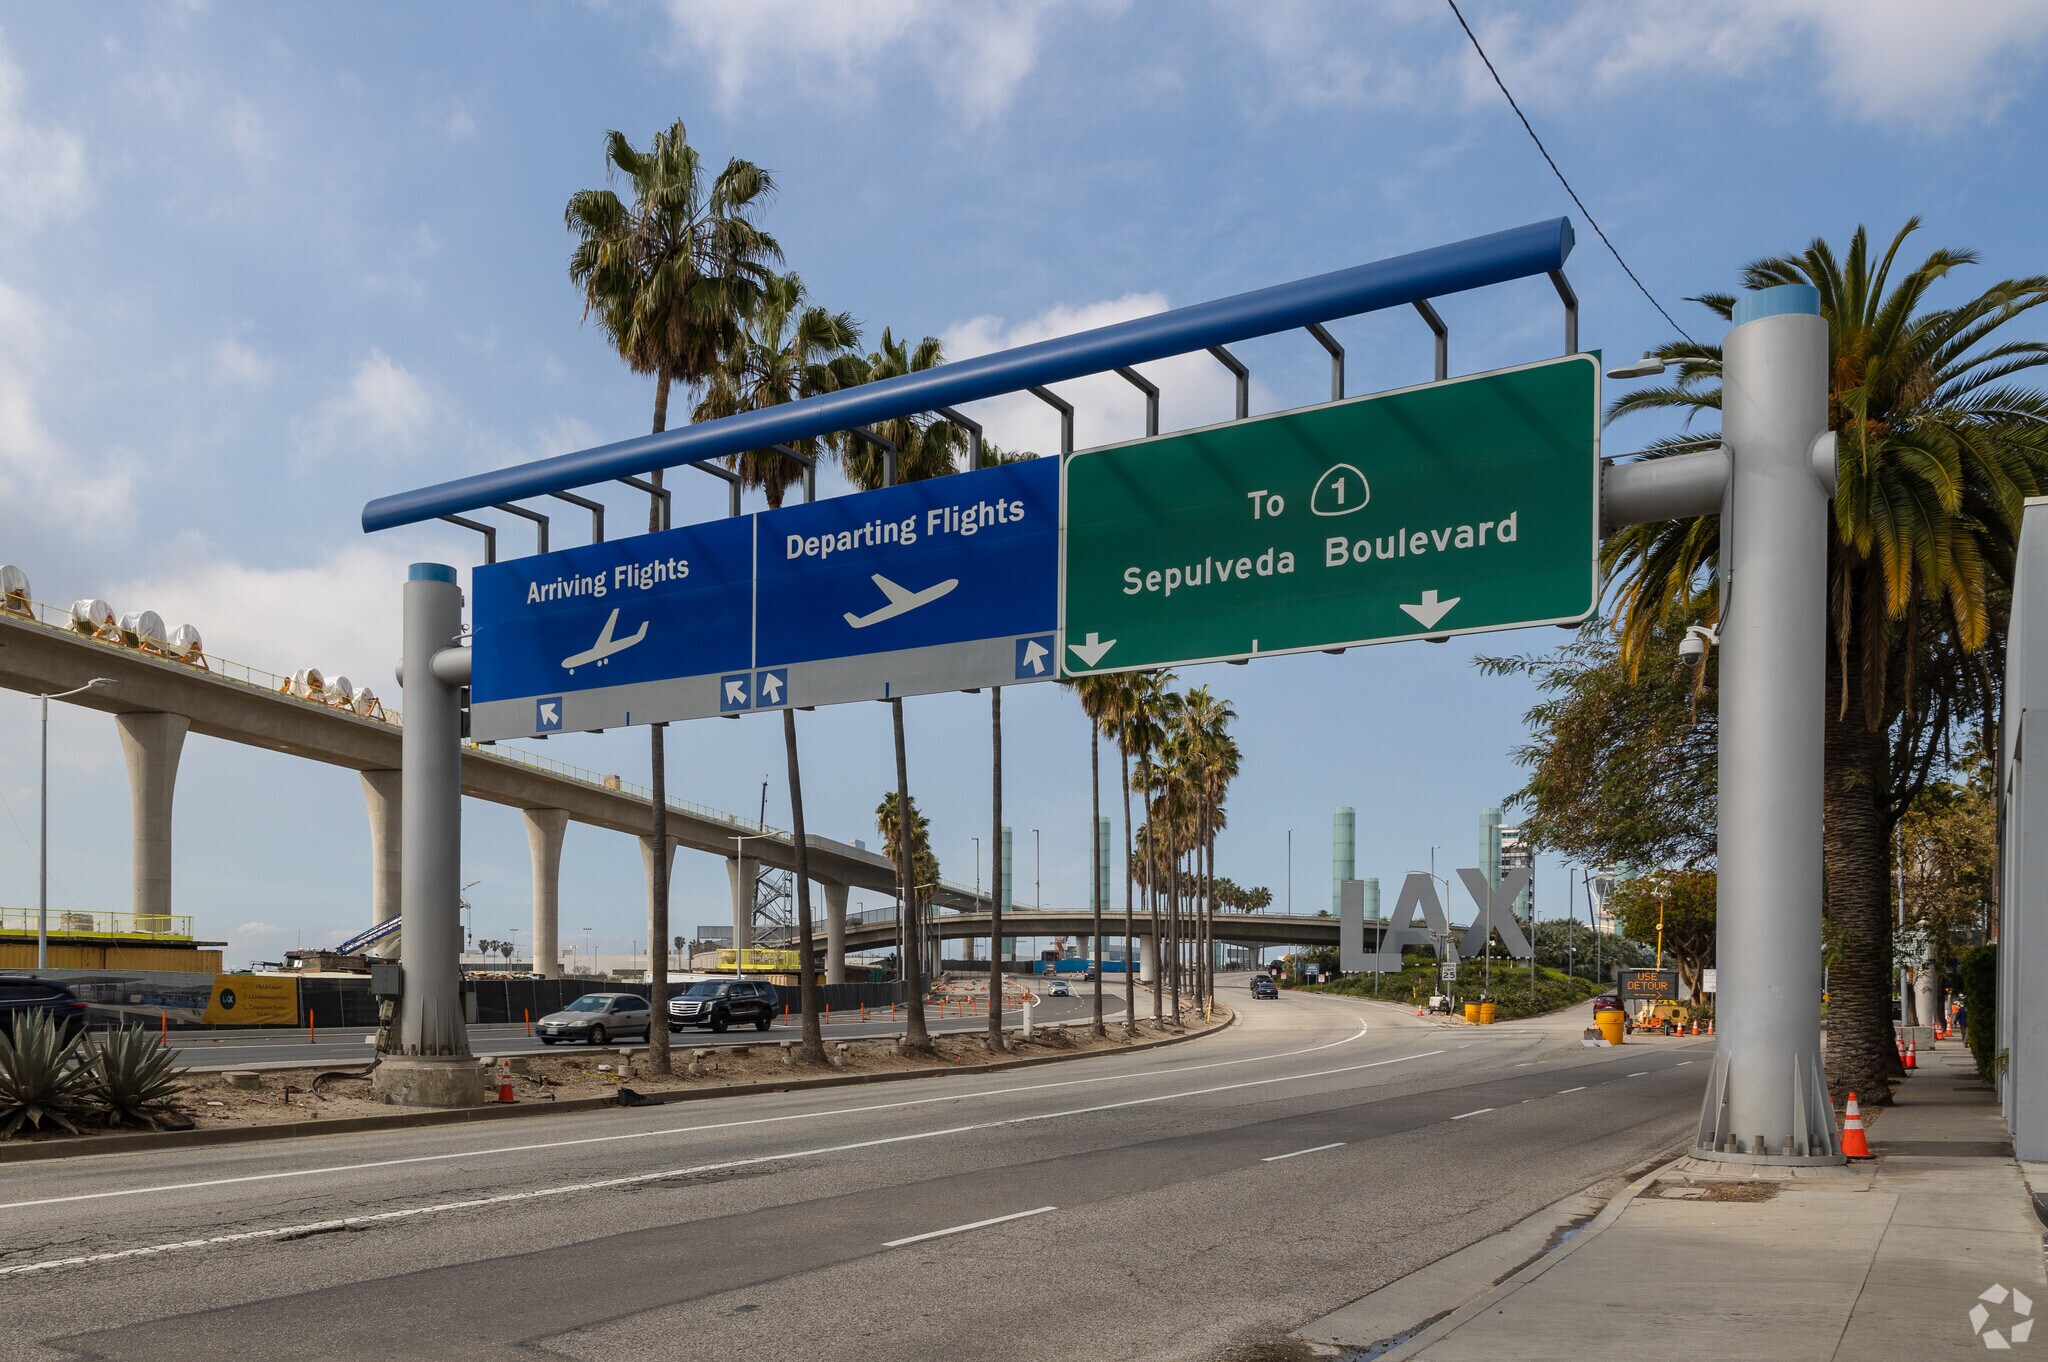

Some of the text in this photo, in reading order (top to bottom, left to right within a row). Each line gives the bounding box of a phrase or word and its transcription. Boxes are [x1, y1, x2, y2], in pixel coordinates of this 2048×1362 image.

[1247, 477, 1345, 520] To 1
[786, 498, 1025, 560] Departing Flights
[1122, 511, 1517, 597] Sepulveda Boulevard
[526, 557, 690, 605] Arriving Flights
[1340, 867, 1534, 973] LAX
[1443, 971, 1455, 979] 25
[1627, 981, 1668, 990] DETOUR
[1637, 972, 1658, 980] USE
